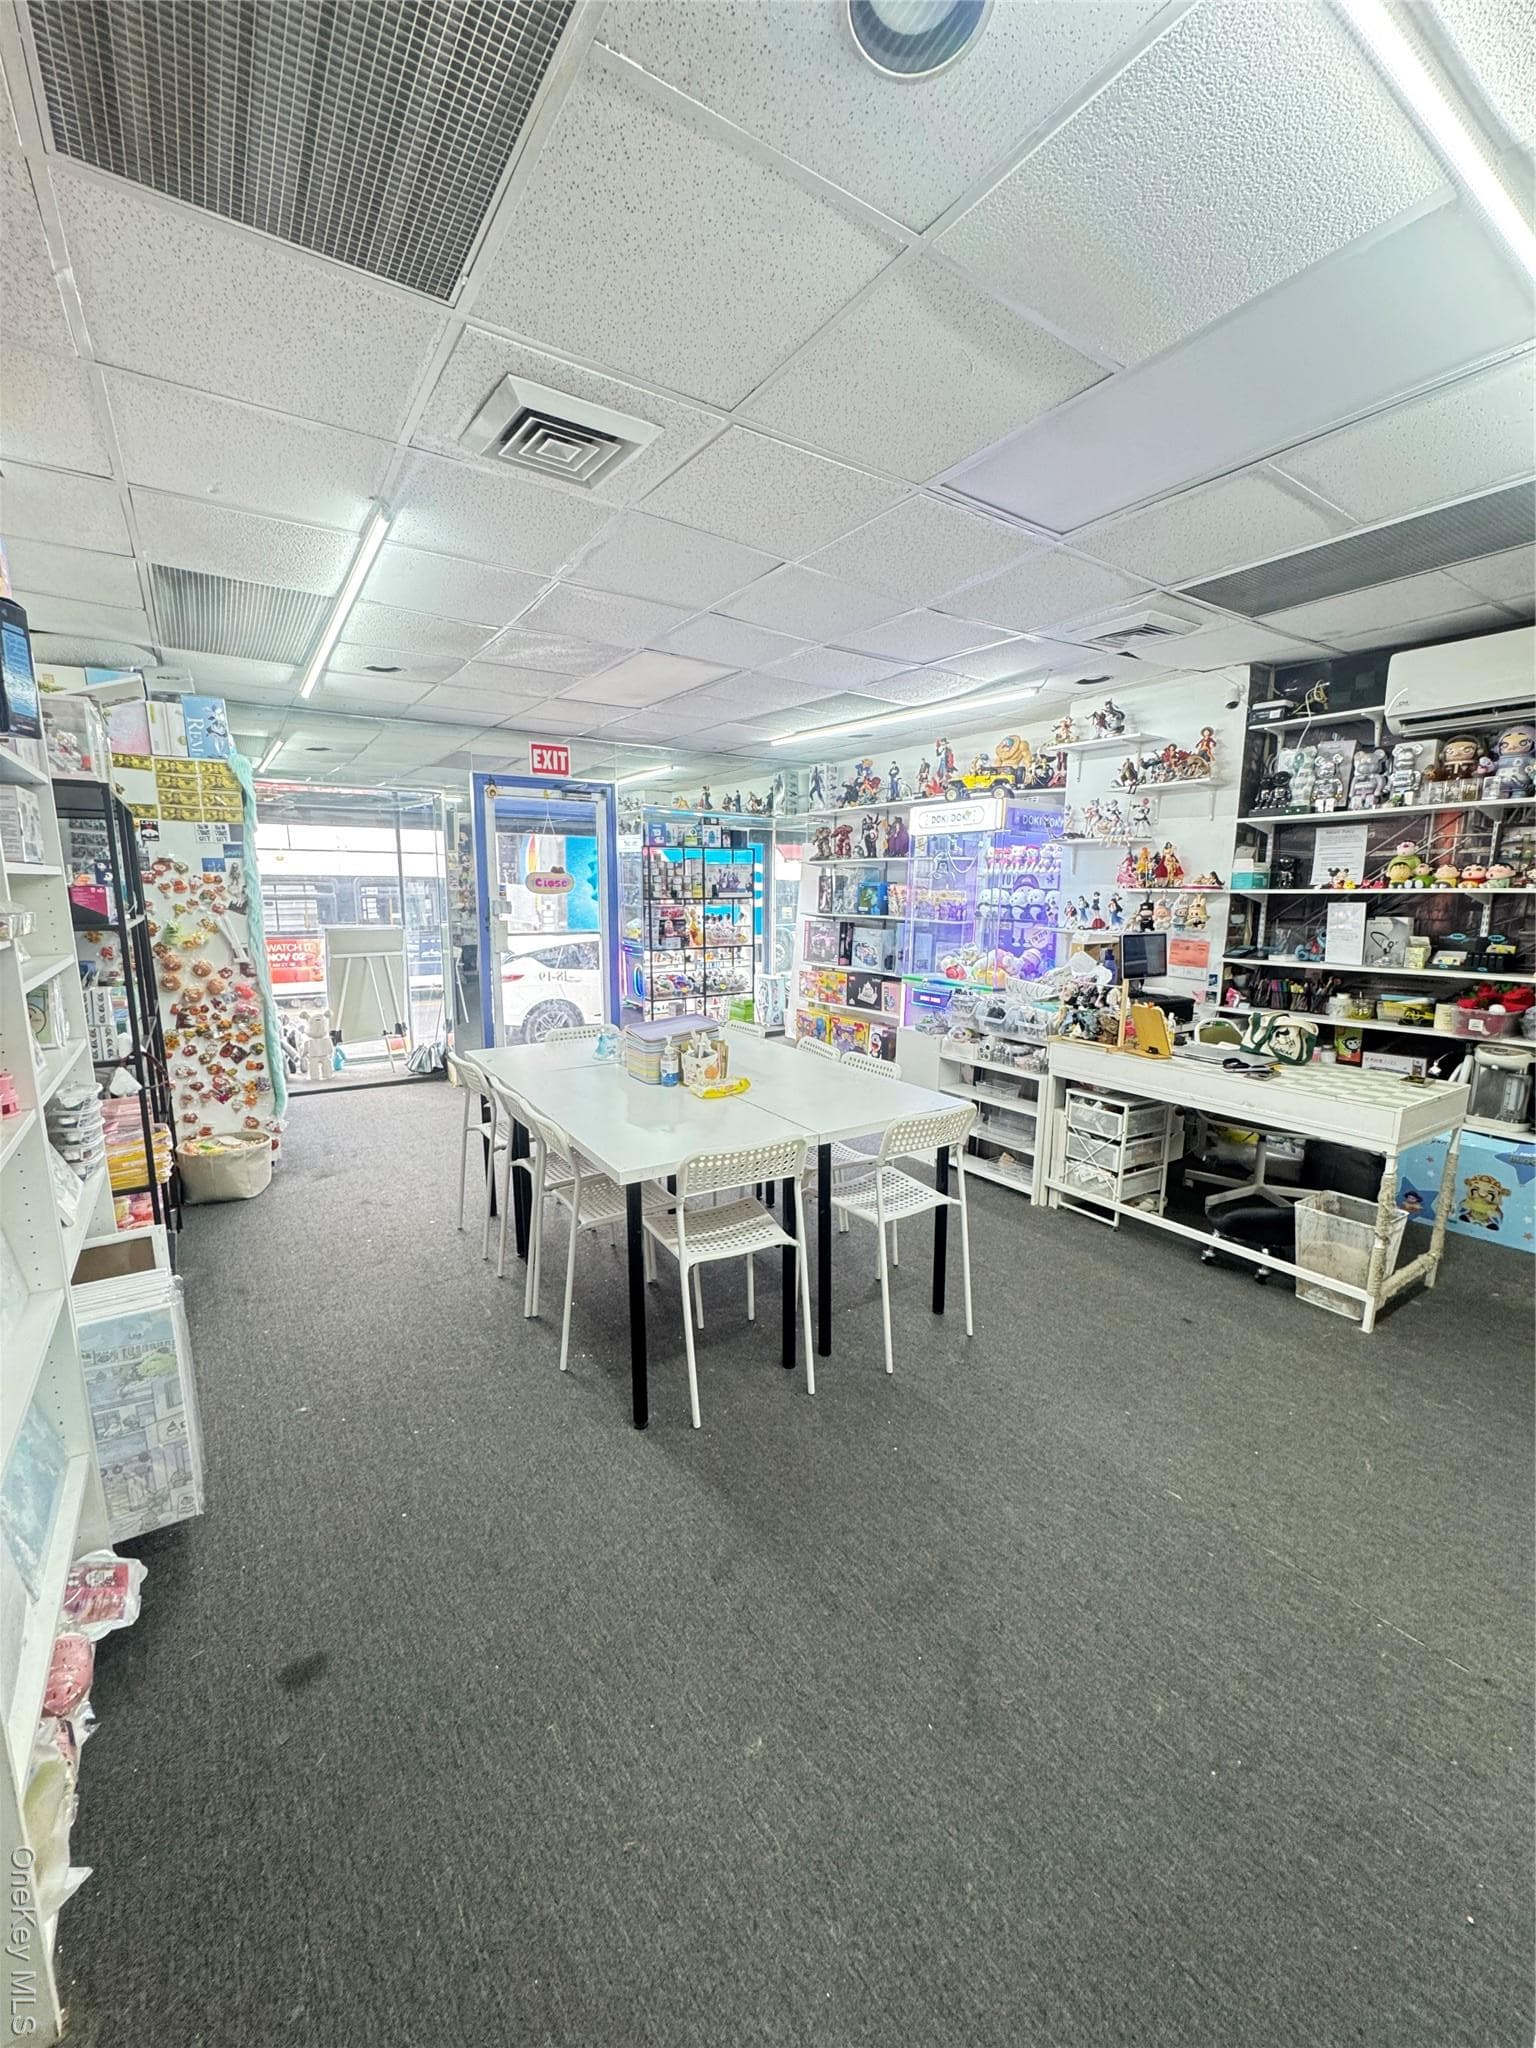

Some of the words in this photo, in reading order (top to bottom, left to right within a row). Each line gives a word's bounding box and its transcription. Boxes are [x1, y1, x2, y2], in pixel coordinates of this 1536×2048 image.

[533, 749, 567, 771] EXIT
[1023, 815, 1042, 825] DOKI
[267, 943, 301, 953] WATCH
